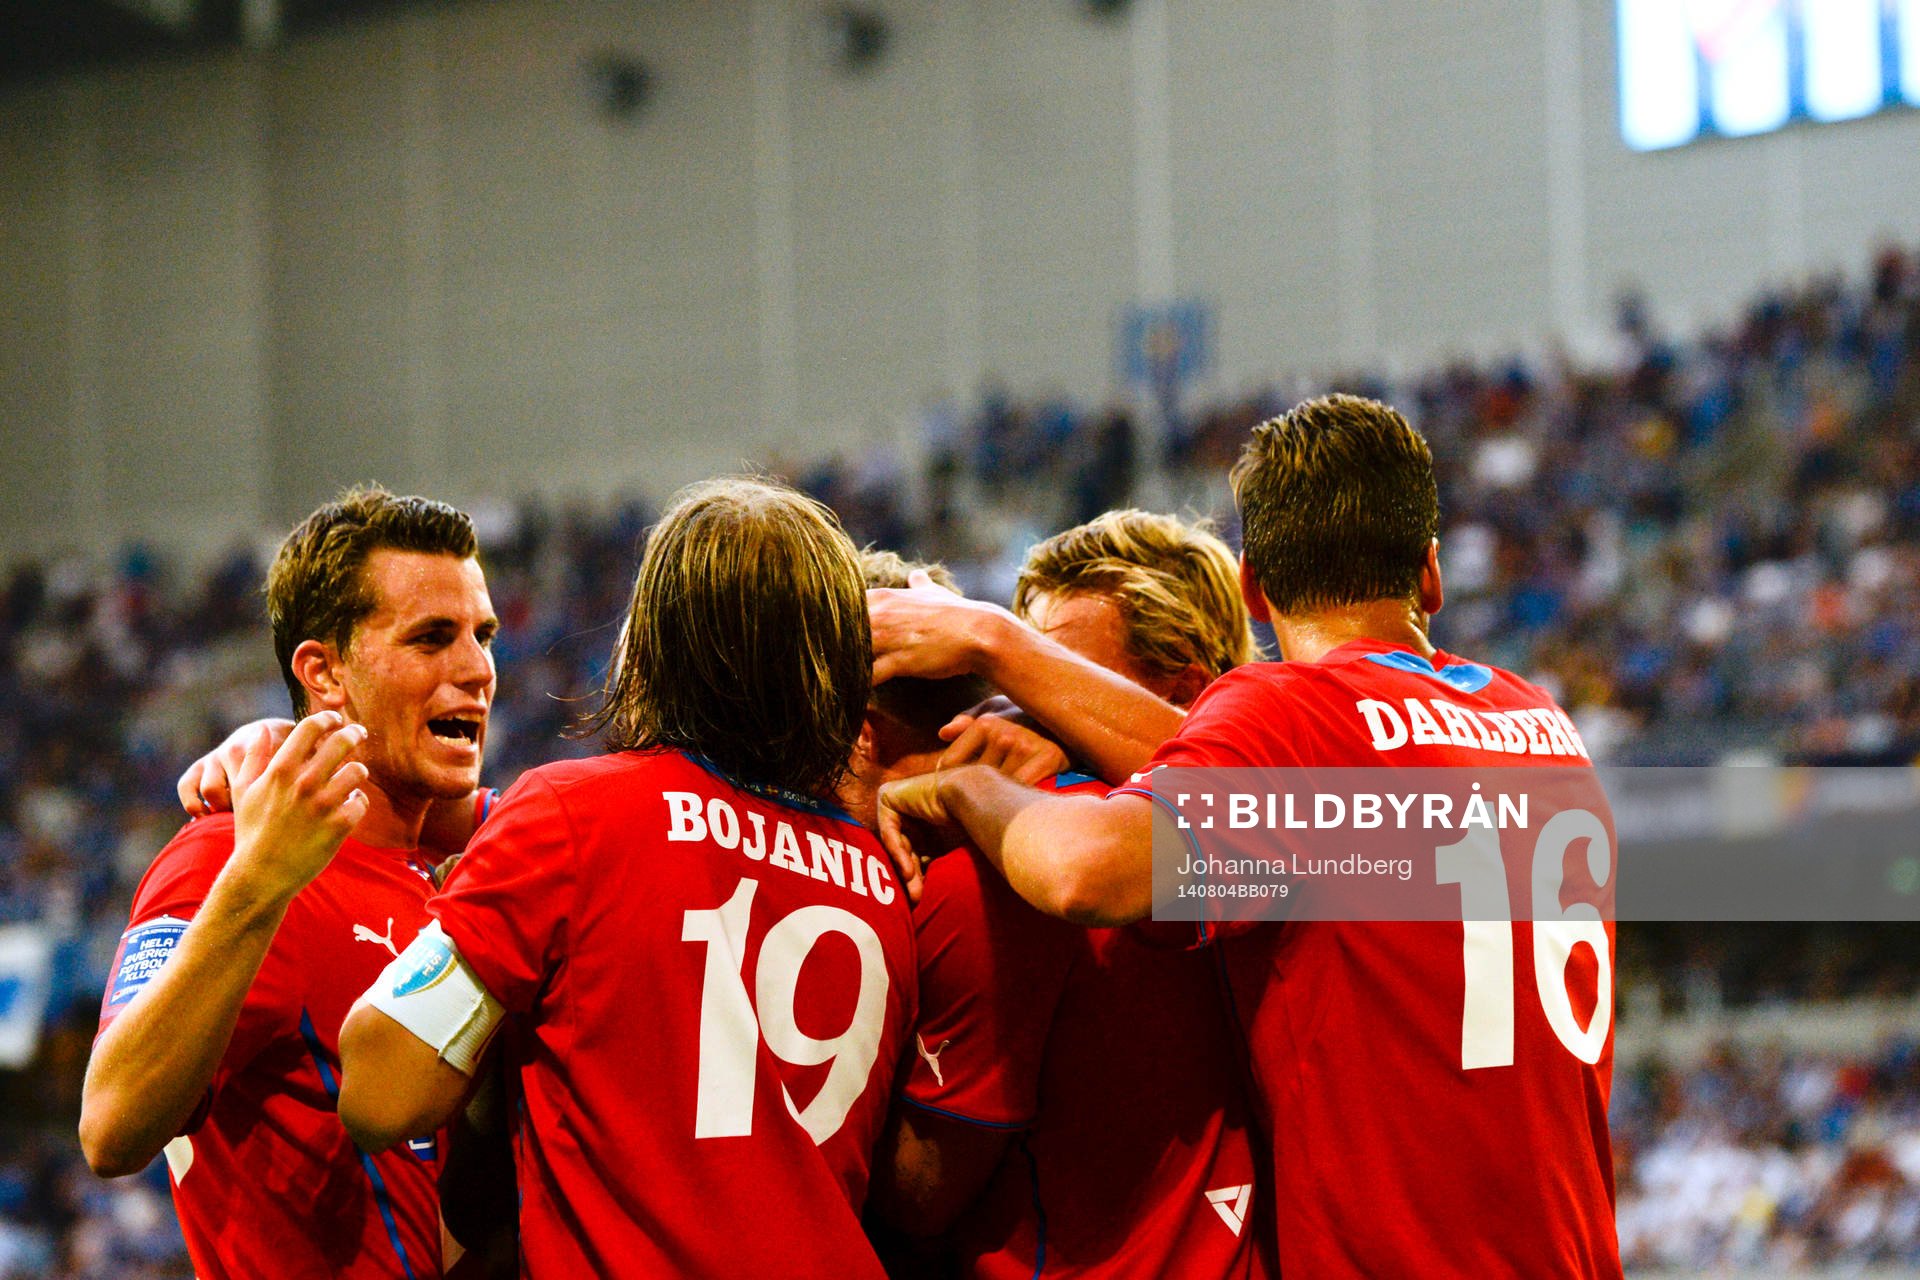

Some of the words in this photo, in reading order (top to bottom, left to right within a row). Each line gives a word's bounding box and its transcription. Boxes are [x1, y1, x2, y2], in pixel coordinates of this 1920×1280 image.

[1355, 697, 1589, 759] DAHLBERG
[662, 791, 895, 905] BOJANIC
[140, 937, 174, 951] HELA
[1435, 801, 1611, 1071] 16
[681, 877, 890, 1146] 19
